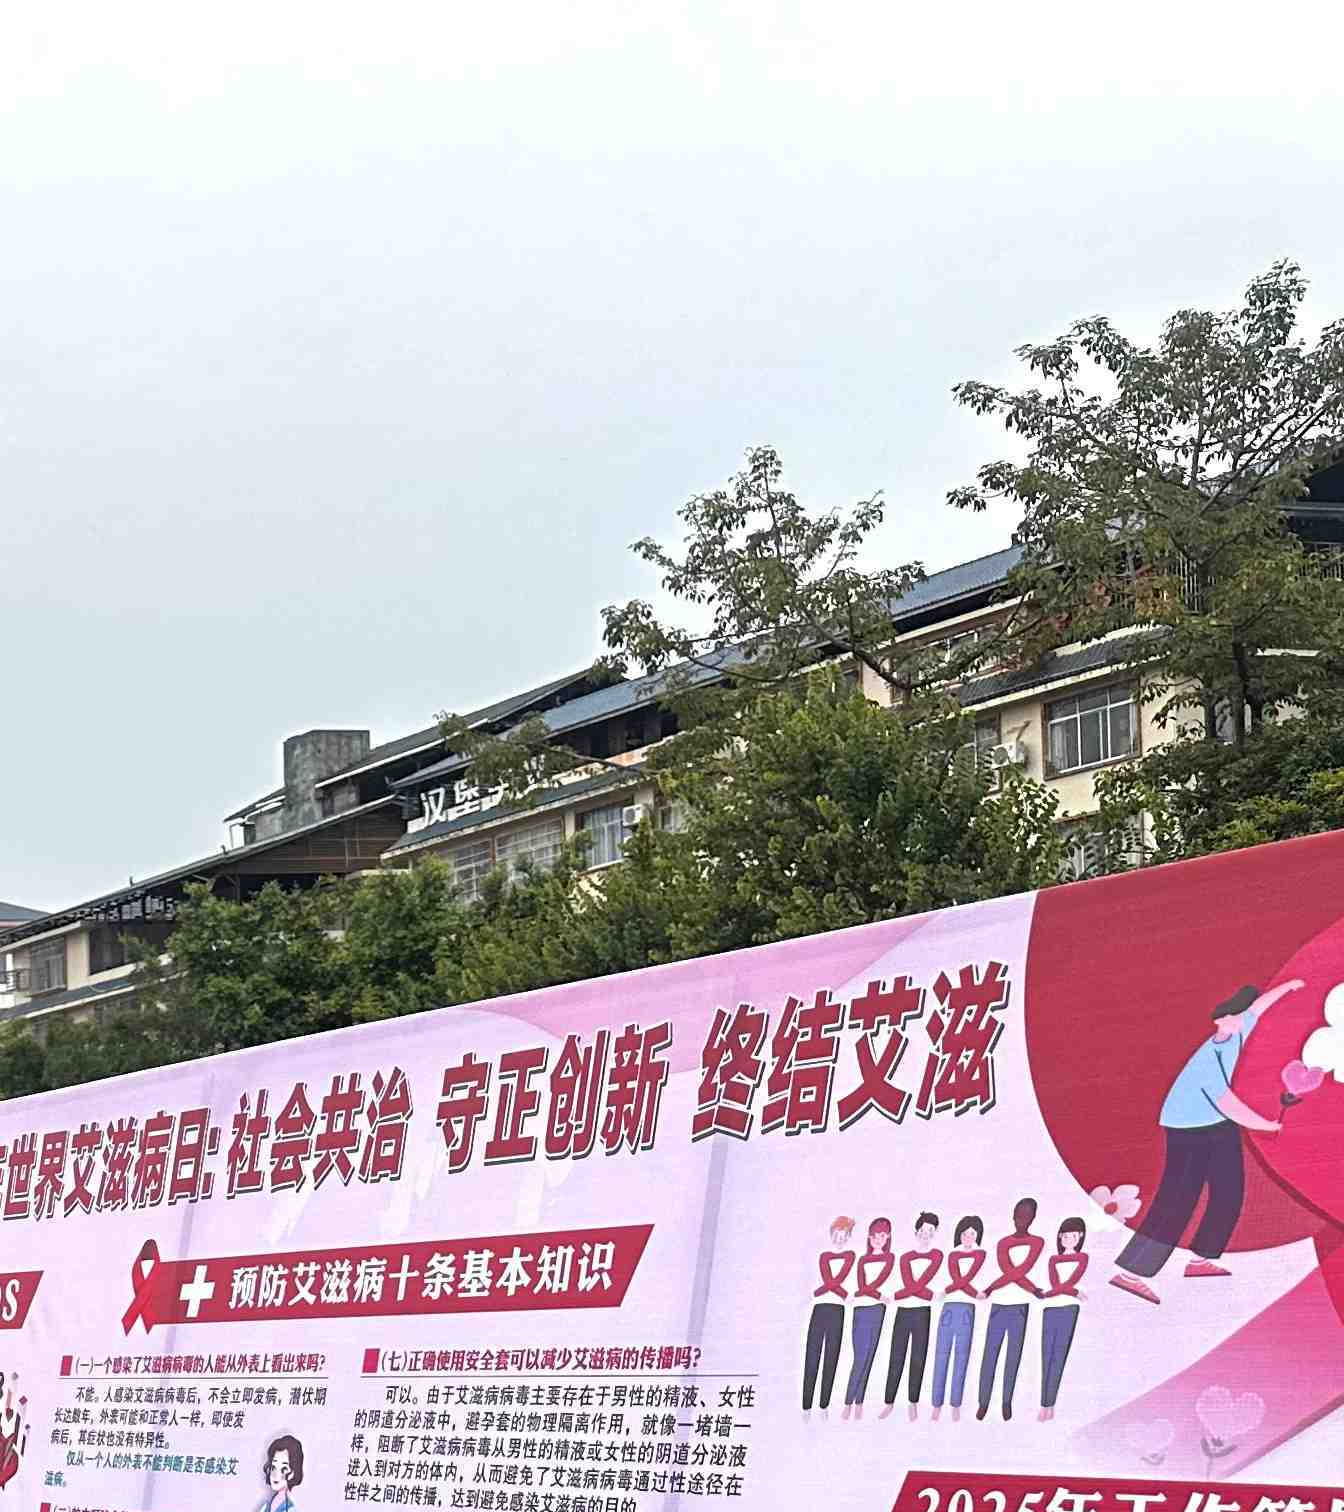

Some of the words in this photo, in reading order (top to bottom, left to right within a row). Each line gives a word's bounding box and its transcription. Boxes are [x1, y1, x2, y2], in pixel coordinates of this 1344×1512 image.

[226, 1065, 411, 1194] 社会共治
[436, 1019, 672, 1174] 守正创新
[692, 960, 1010, 1143] 终结艾滋
[229, 1240, 615, 1312] 预防艾滋病十条基本知识
[381, 1346, 701, 1374] (七)正确使用安全套可以减少艾滋病的传播吗?
[385, 1384, 755, 1409] 可以。由于艾滋病病毒主要存在于男性的精液、女性
[354, 1409, 752, 1438] 的阴道分泌液中，避孕套的物理隔离作用，就像一堵墙一
[351, 1433, 747, 1468] 样，阻断了艾滋病病毒从男性的精液或女性的阴道分泌液
[347, 1458, 743, 1497] 进入到对方的体内，从而避免了艾滋病病毒通过性途径在
